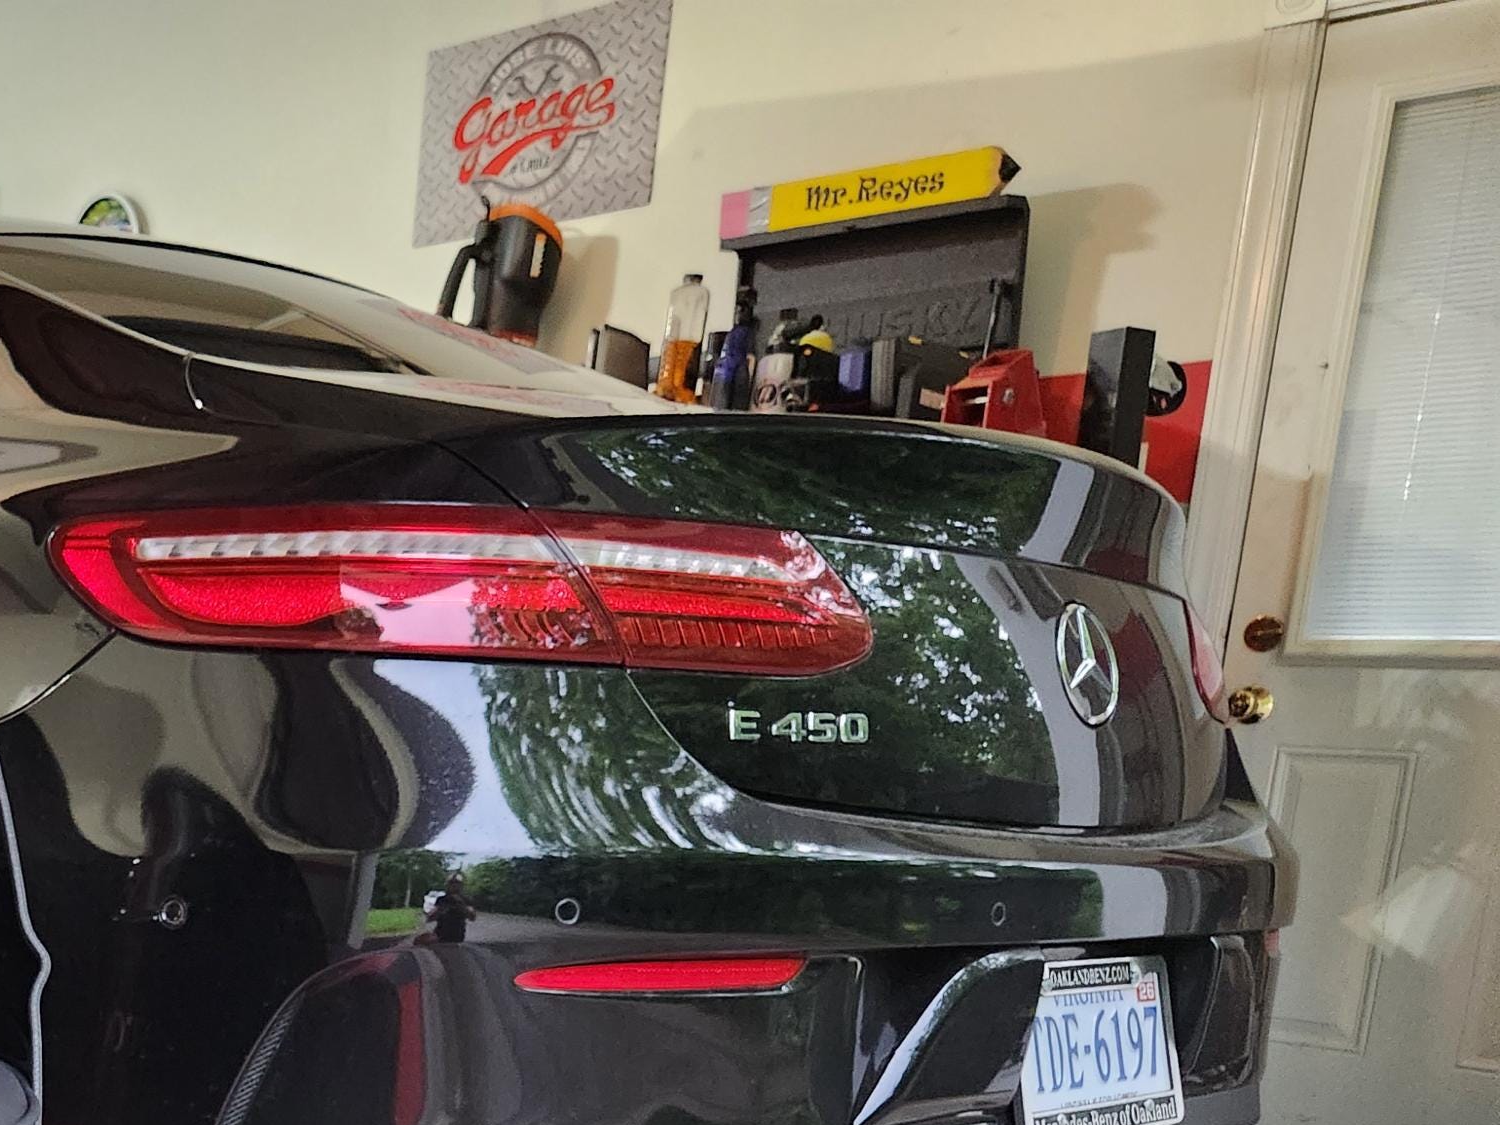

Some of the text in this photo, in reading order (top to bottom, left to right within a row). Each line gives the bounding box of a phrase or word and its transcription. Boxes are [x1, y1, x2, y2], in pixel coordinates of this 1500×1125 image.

[454, 77, 616, 185] Garage
[728, 709, 869, 743] E 450
[1050, 965, 1131, 989] OAKLANDBENZ.COM
[1138, 982, 1155, 1000] 26
[1129, 1095, 1177, 1123] Oakland
